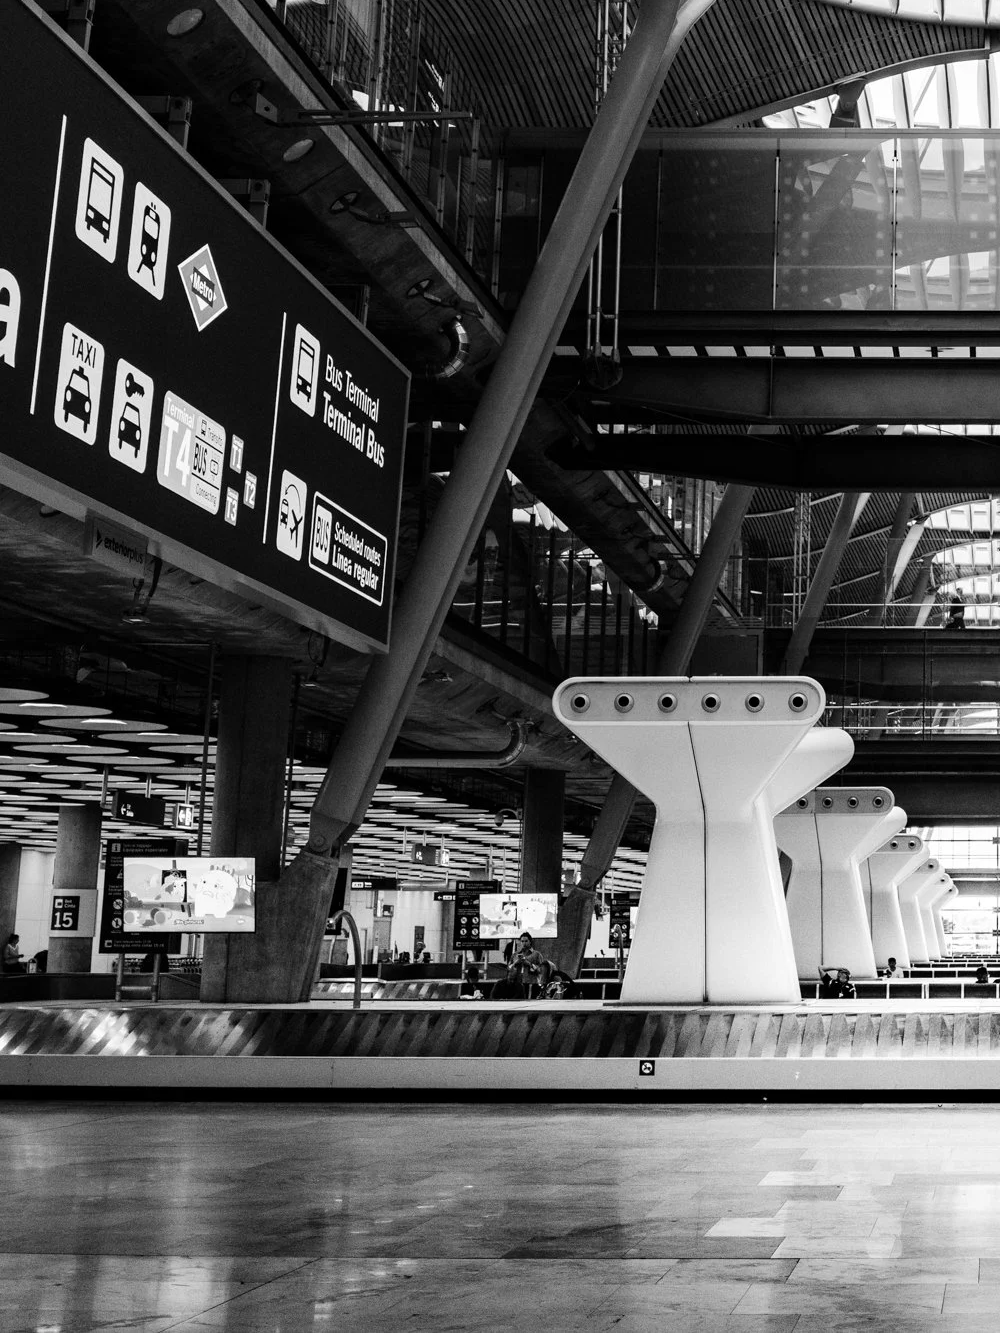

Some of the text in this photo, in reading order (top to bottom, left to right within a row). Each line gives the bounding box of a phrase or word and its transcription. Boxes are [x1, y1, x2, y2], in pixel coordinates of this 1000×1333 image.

[193, 272, 213, 302] Metro
[72, 333, 96, 368] TAXI
[325, 354, 379, 423] Bus Terminal
[167, 397, 195, 428] Terminal
[323, 391, 385, 468] Terminal Bus
[163, 414, 192, 487] T4
[193, 442, 207, 476] BUS
[232, 443, 242, 471] T1
[226, 496, 237, 521] T3
[245, 480, 256, 508] T2
[315, 516, 329, 553] BUS
[334, 522, 381, 566] Scheduled routes
[332, 544, 379, 590] Línea regular
[54, 912, 73, 928] 15
